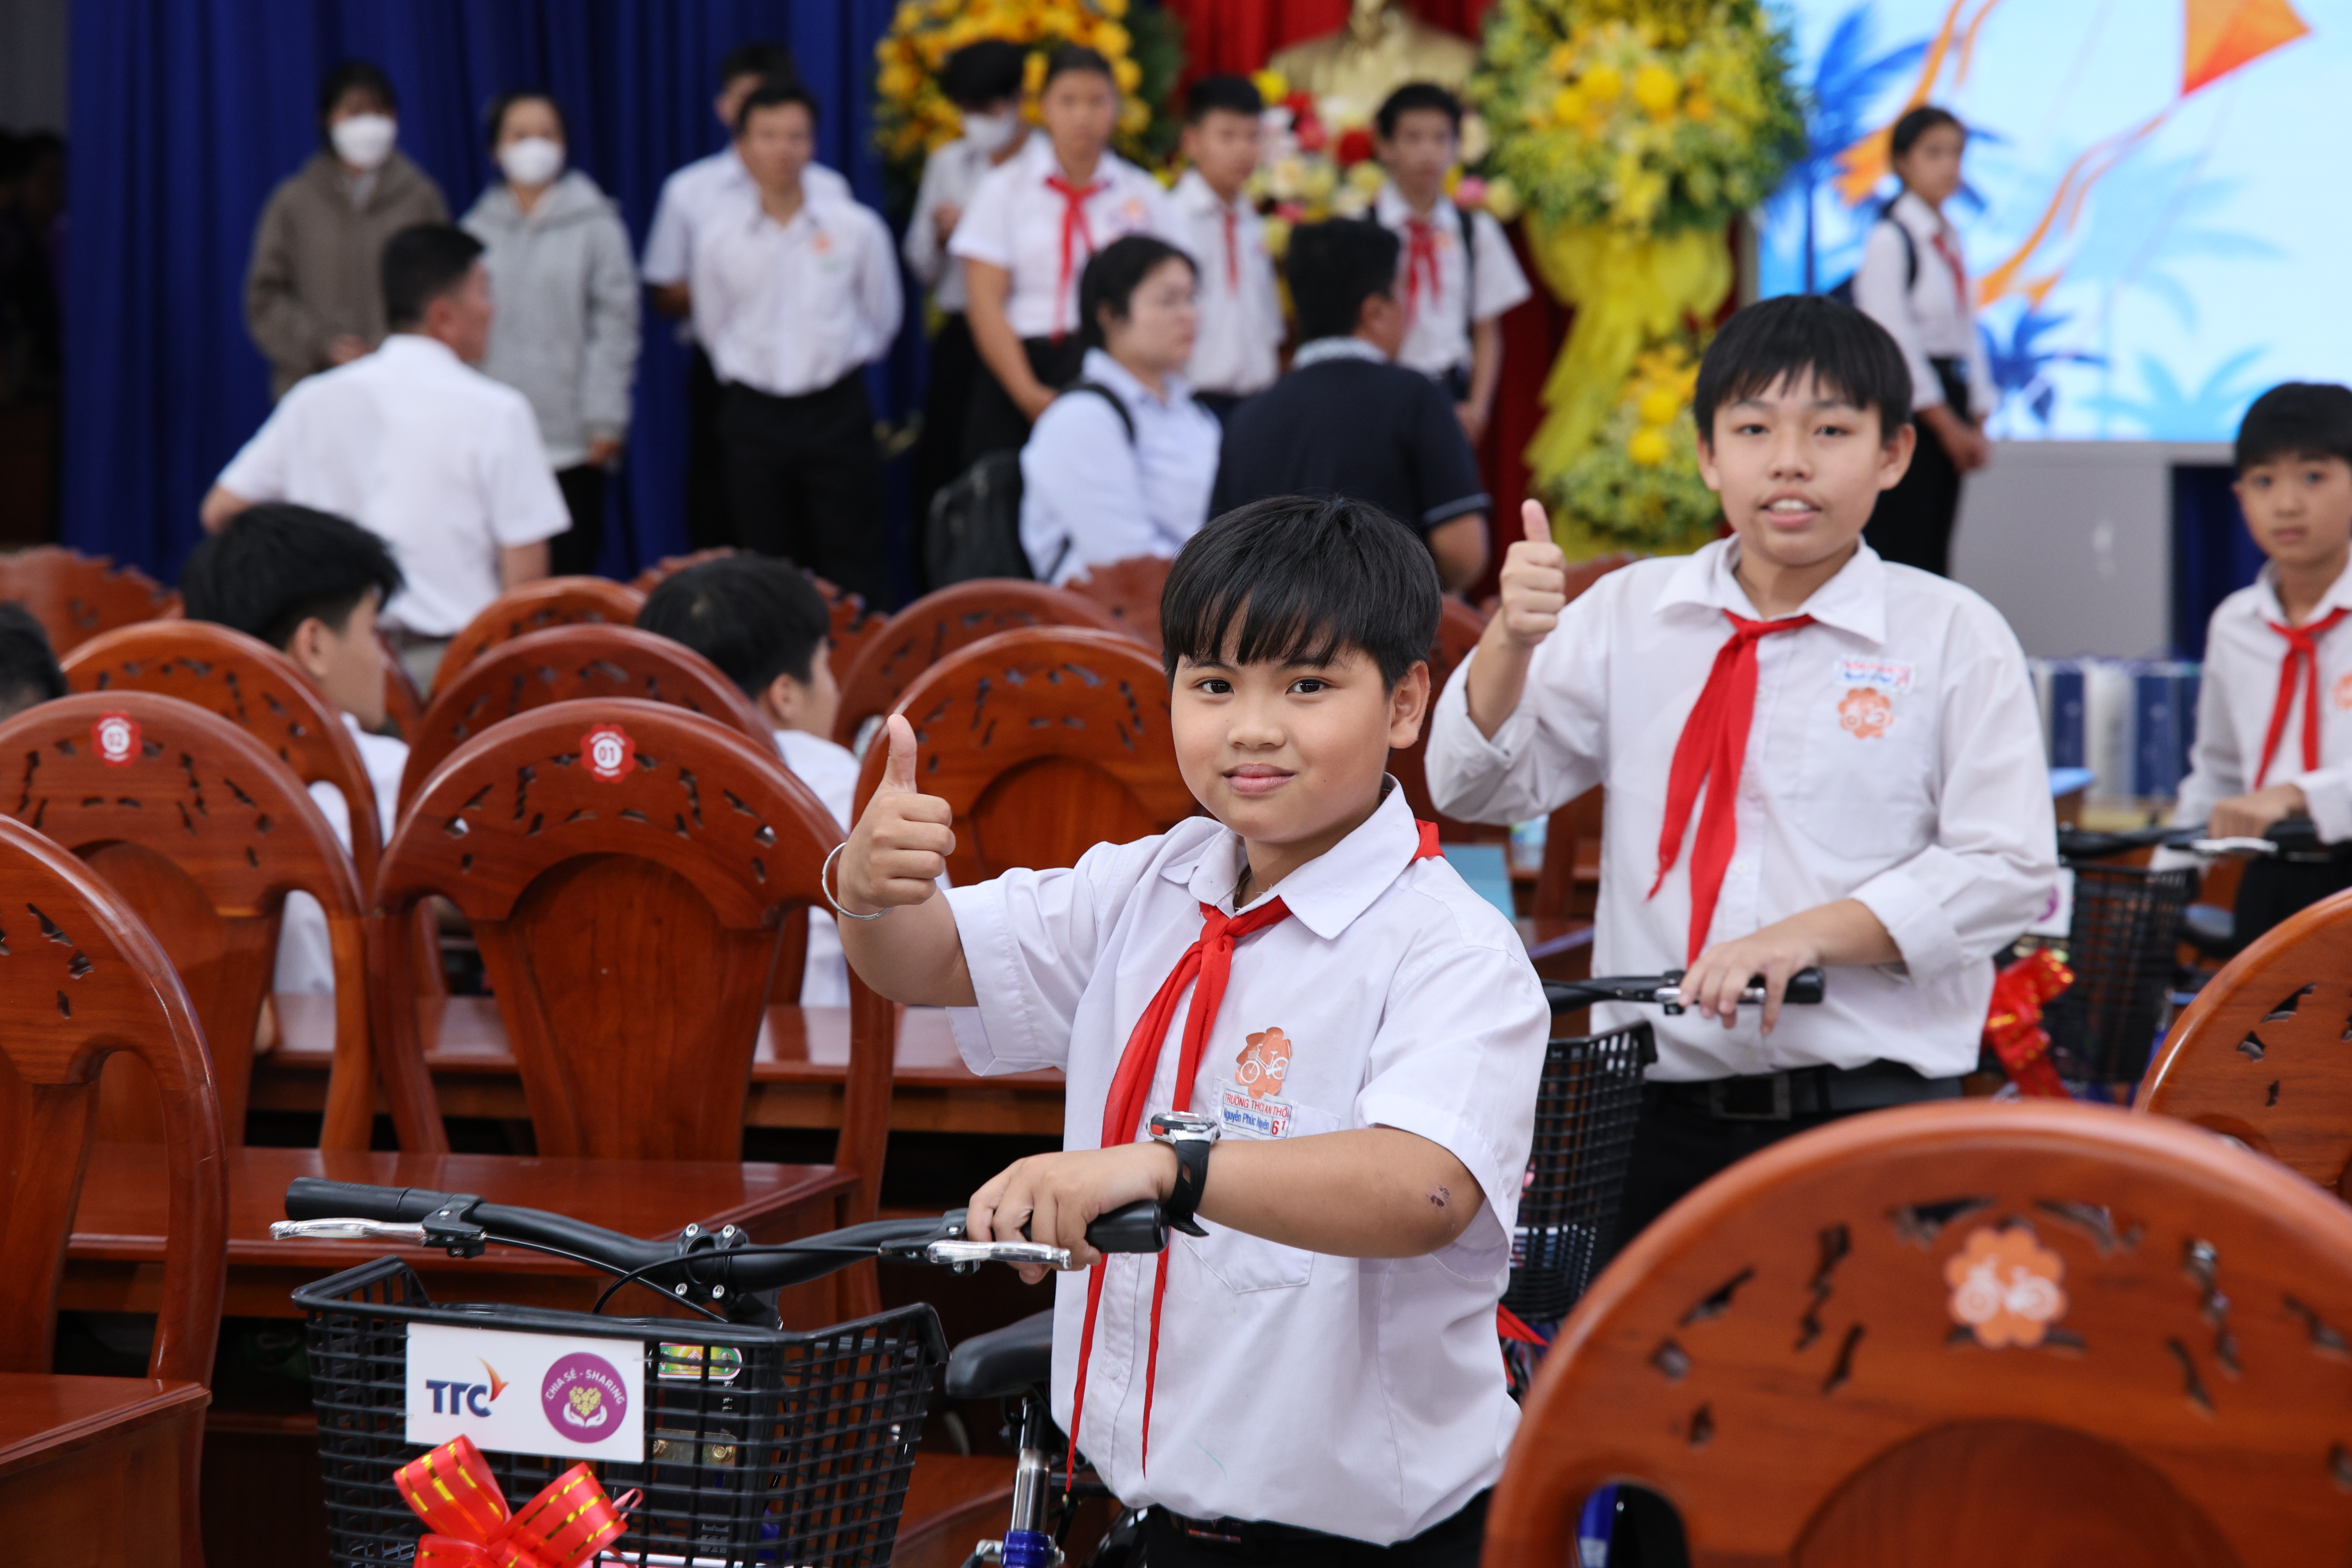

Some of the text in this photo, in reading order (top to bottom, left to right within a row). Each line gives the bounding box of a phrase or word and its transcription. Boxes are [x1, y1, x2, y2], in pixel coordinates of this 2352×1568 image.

[598, 746, 615, 761] 01
[1225, 1093, 1249, 1108] TRƯỜNG
[1264, 1105, 1272, 1115] AN
[1224, 1107, 1241, 1122] Nguyễn
[1243, 1113, 1256, 1126] Phúc
[426, 1379, 492, 1417] TTC
[545, 1377, 565, 1400] CHIA
[585, 1369, 625, 1405] SHARING
